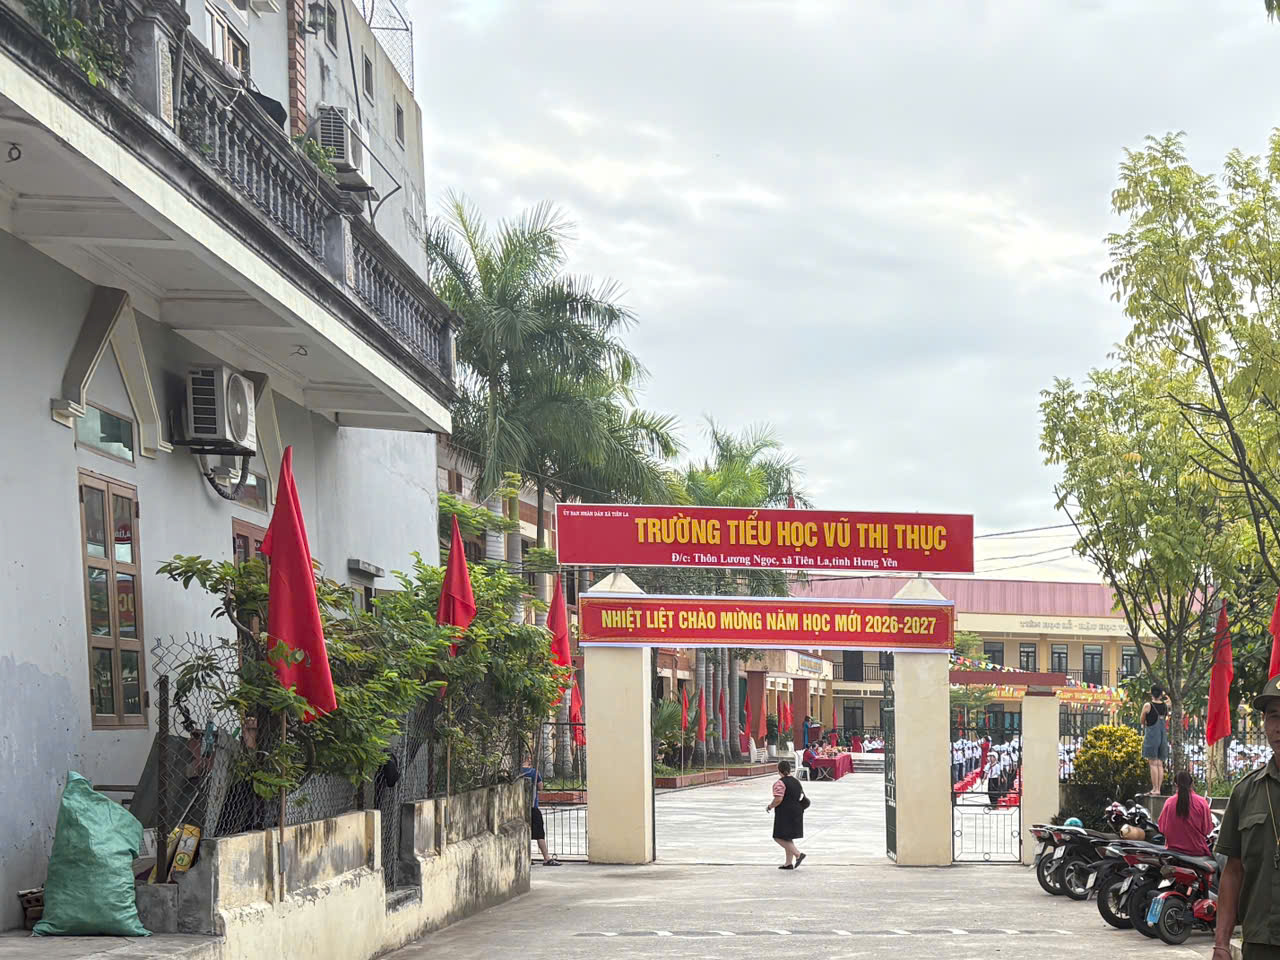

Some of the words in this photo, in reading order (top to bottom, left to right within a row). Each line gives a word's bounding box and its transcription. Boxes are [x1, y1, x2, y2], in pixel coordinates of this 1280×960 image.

[635, 513, 721, 545] TRƯỜNG
[727, 511, 771, 546] TIỂU
[777, 521, 818, 552] HỌC
[823, 517, 851, 548] VŨ
[856, 523, 889, 554] THỊ
[894, 524, 947, 556] THỤC
[671, 552, 691, 563] Đ/c:
[693, 553, 718, 563] Thôn
[720, 553, 751, 566] Lương
[753, 554, 780, 567] Ngọc,
[782, 556, 793, 566] xã
[794, 555, 815, 566] Tiên
[853, 557, 880, 569] Hưng
[881, 556, 899, 568] Yên
[602, 607, 642, 632] NHIỆT
[646, 607, 675, 633] LIỆT
[678, 608, 716, 629] CHÀO
[720, 608, 763, 630] MỪNG
[766, 609, 799, 631] NĂM
[803, 613, 831, 635] HỌC
[835, 610, 862, 633] MỚI
[865, 615, 937, 635] 2026-2027
